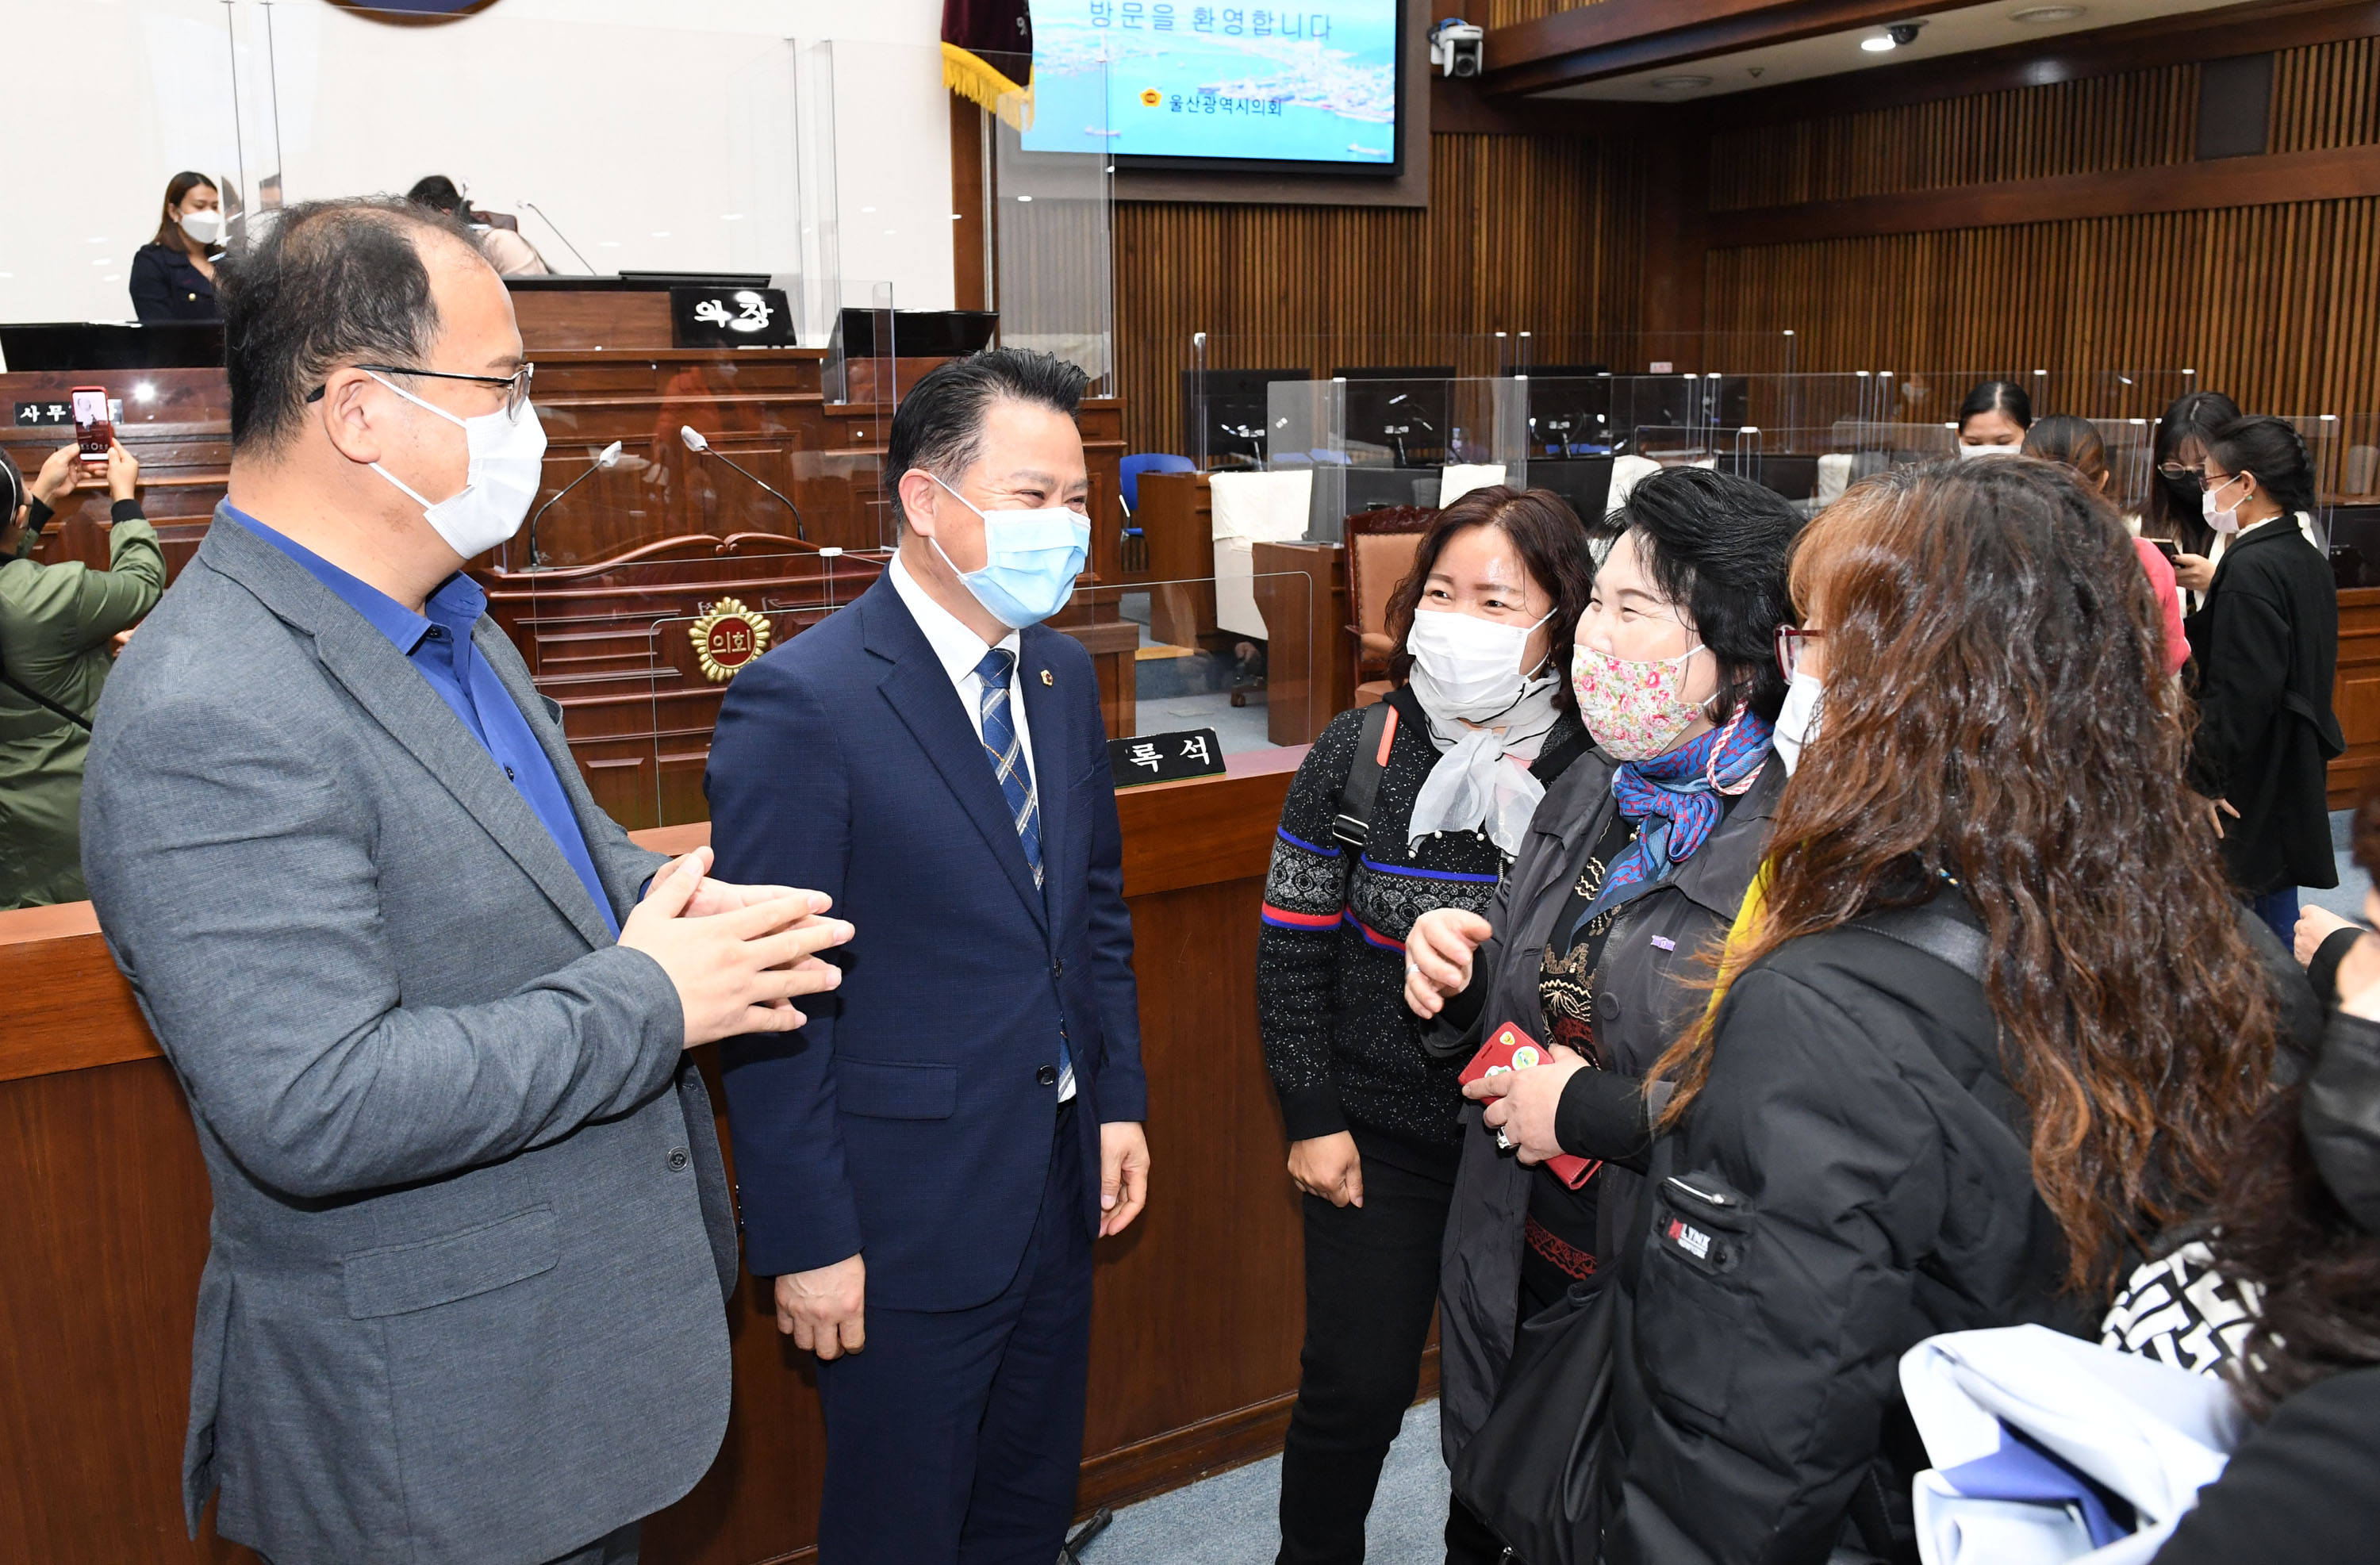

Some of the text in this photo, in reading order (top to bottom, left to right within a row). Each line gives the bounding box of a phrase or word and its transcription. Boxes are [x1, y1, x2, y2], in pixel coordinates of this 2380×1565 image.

[1090, 0, 1333, 40] 방문을 환영합니다
[1169, 94, 1282, 117] 울산광역시의회
[711, 629, 751, 654] 의회
[1125, 735, 1211, 773] 록석
